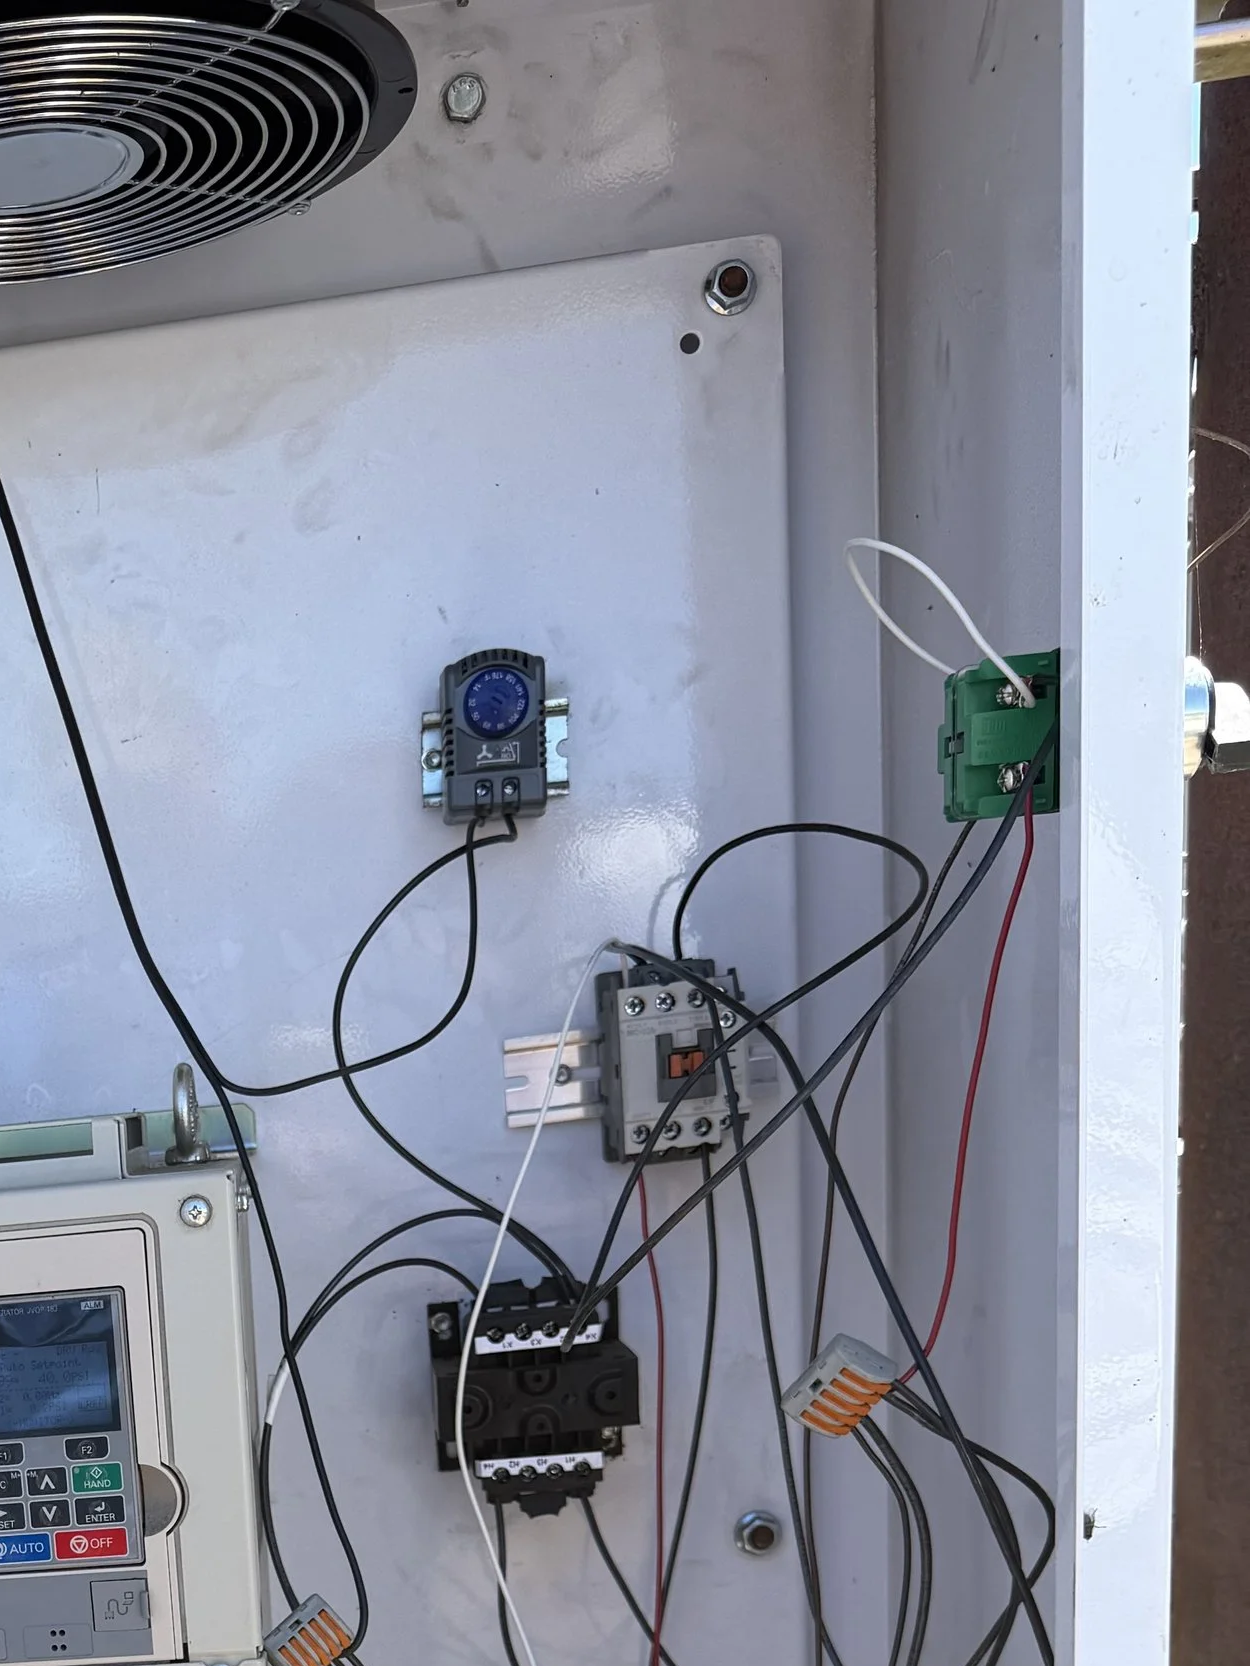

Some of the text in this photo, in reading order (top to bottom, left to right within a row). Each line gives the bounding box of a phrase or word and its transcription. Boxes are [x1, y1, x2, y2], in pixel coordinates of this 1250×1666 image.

[501, 1341, 513, 1349] X1
[529, 1338, 541, 1346] X3
[81, 1446, 92, 1454] F2
[84, 1479, 111, 1489] HAND
[85, 1514, 116, 1523] ENTER
[91, 1537, 113, 1548] OFF
[10, 1542, 44, 1554] AUTO
